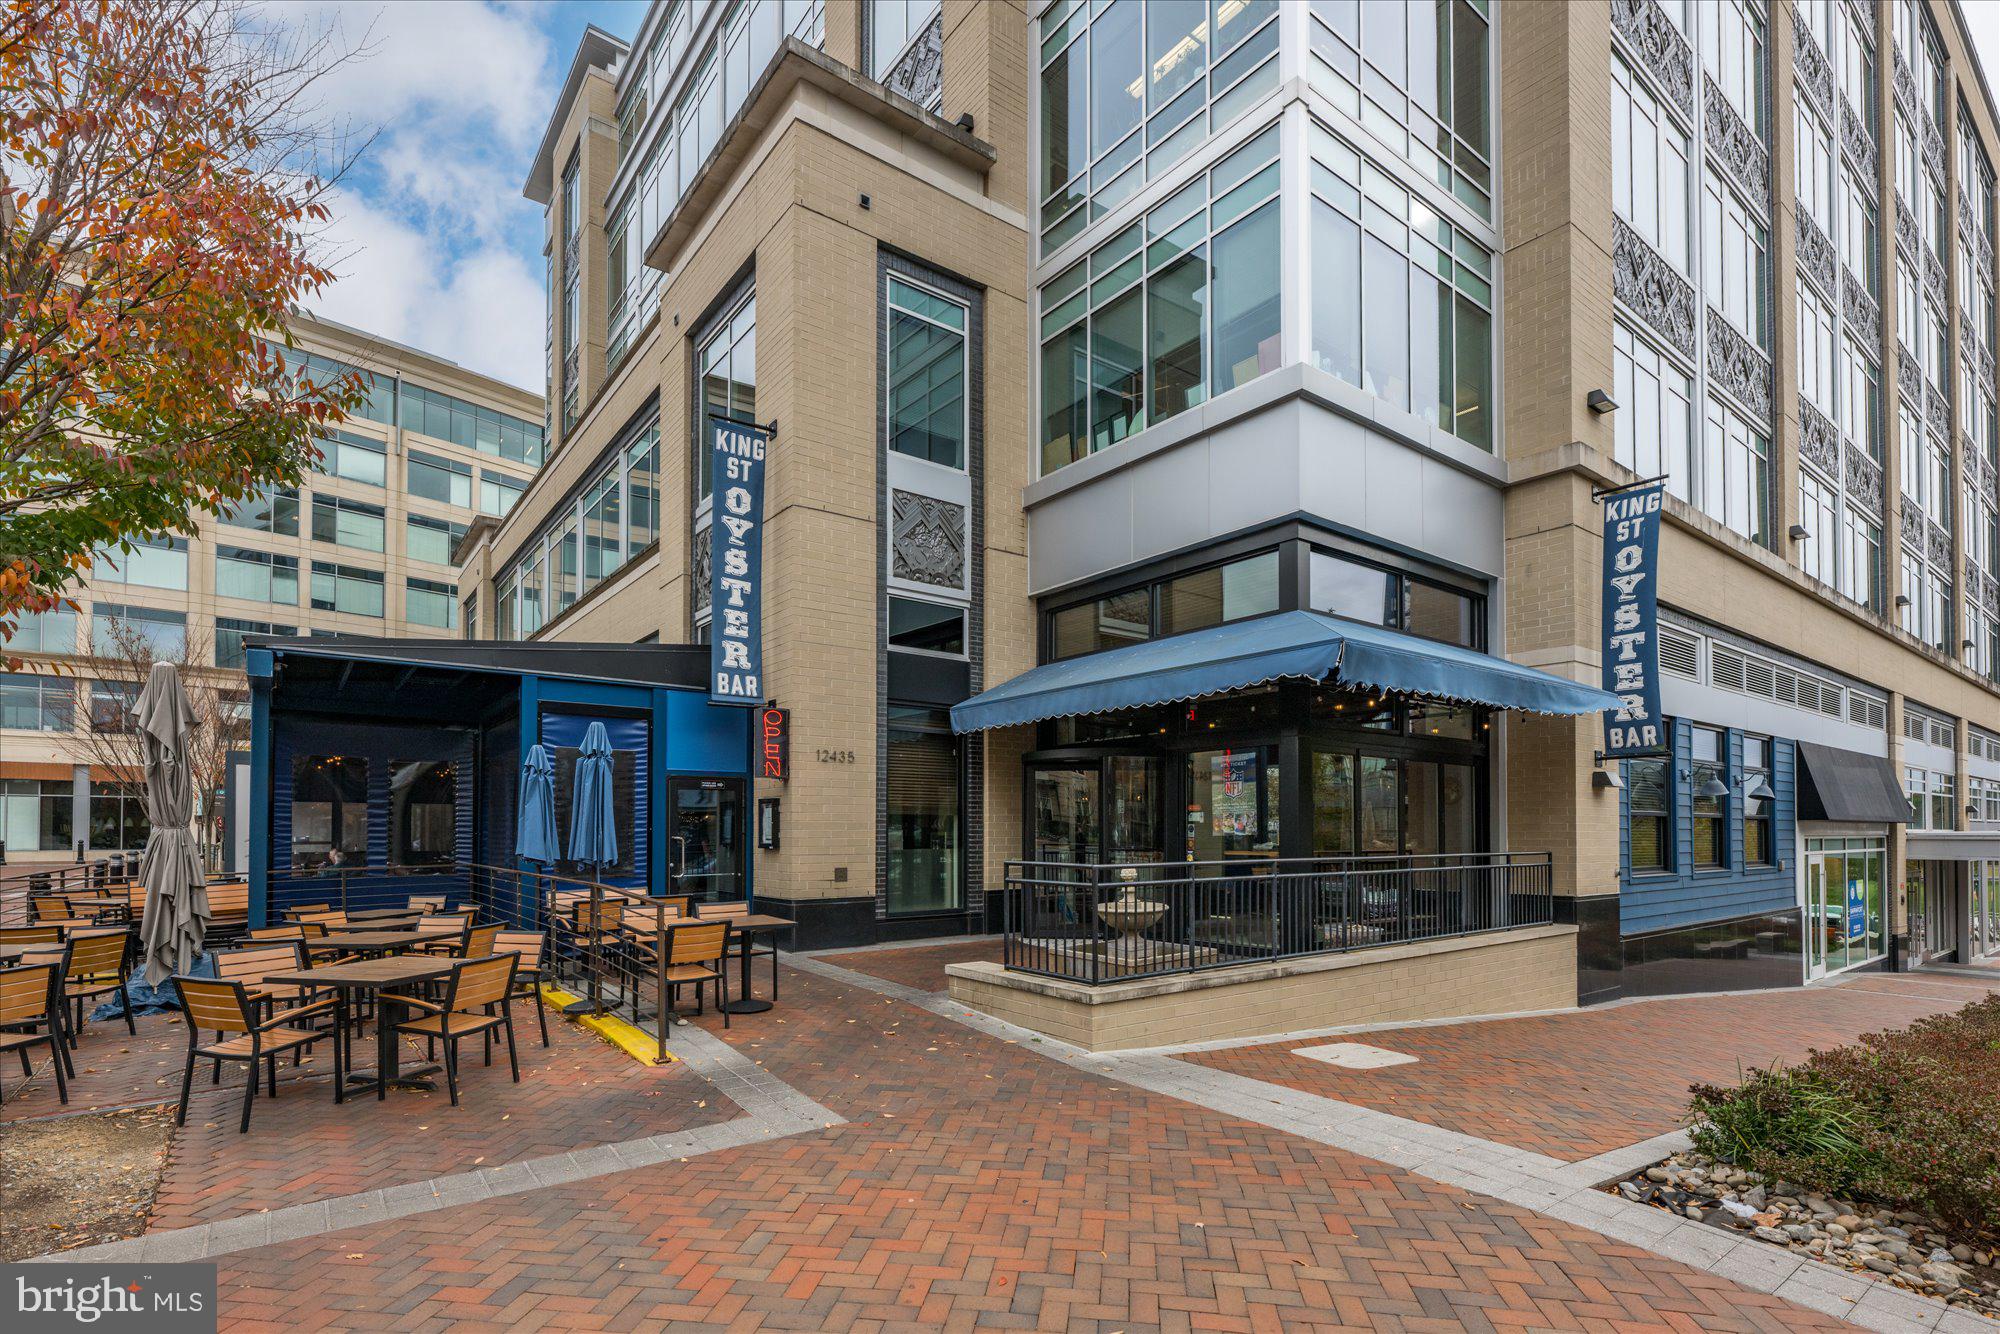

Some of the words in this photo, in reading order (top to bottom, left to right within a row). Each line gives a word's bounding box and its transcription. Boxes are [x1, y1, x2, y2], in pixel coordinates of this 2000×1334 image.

[715, 428, 765, 461] KING
[726, 456, 753, 482] ST
[1605, 491, 1661, 523] KING
[1616, 517, 1645, 543] ST
[721, 486, 754, 670] OYSTER
[1610, 544, 1649, 722] OYSTER
[717, 672, 758, 697] BAR
[763, 710, 783, 777] OPEN
[1609, 725, 1657, 749] BAR
[816, 749, 855, 764] 12435
[1225, 781, 1242, 795] NFL
